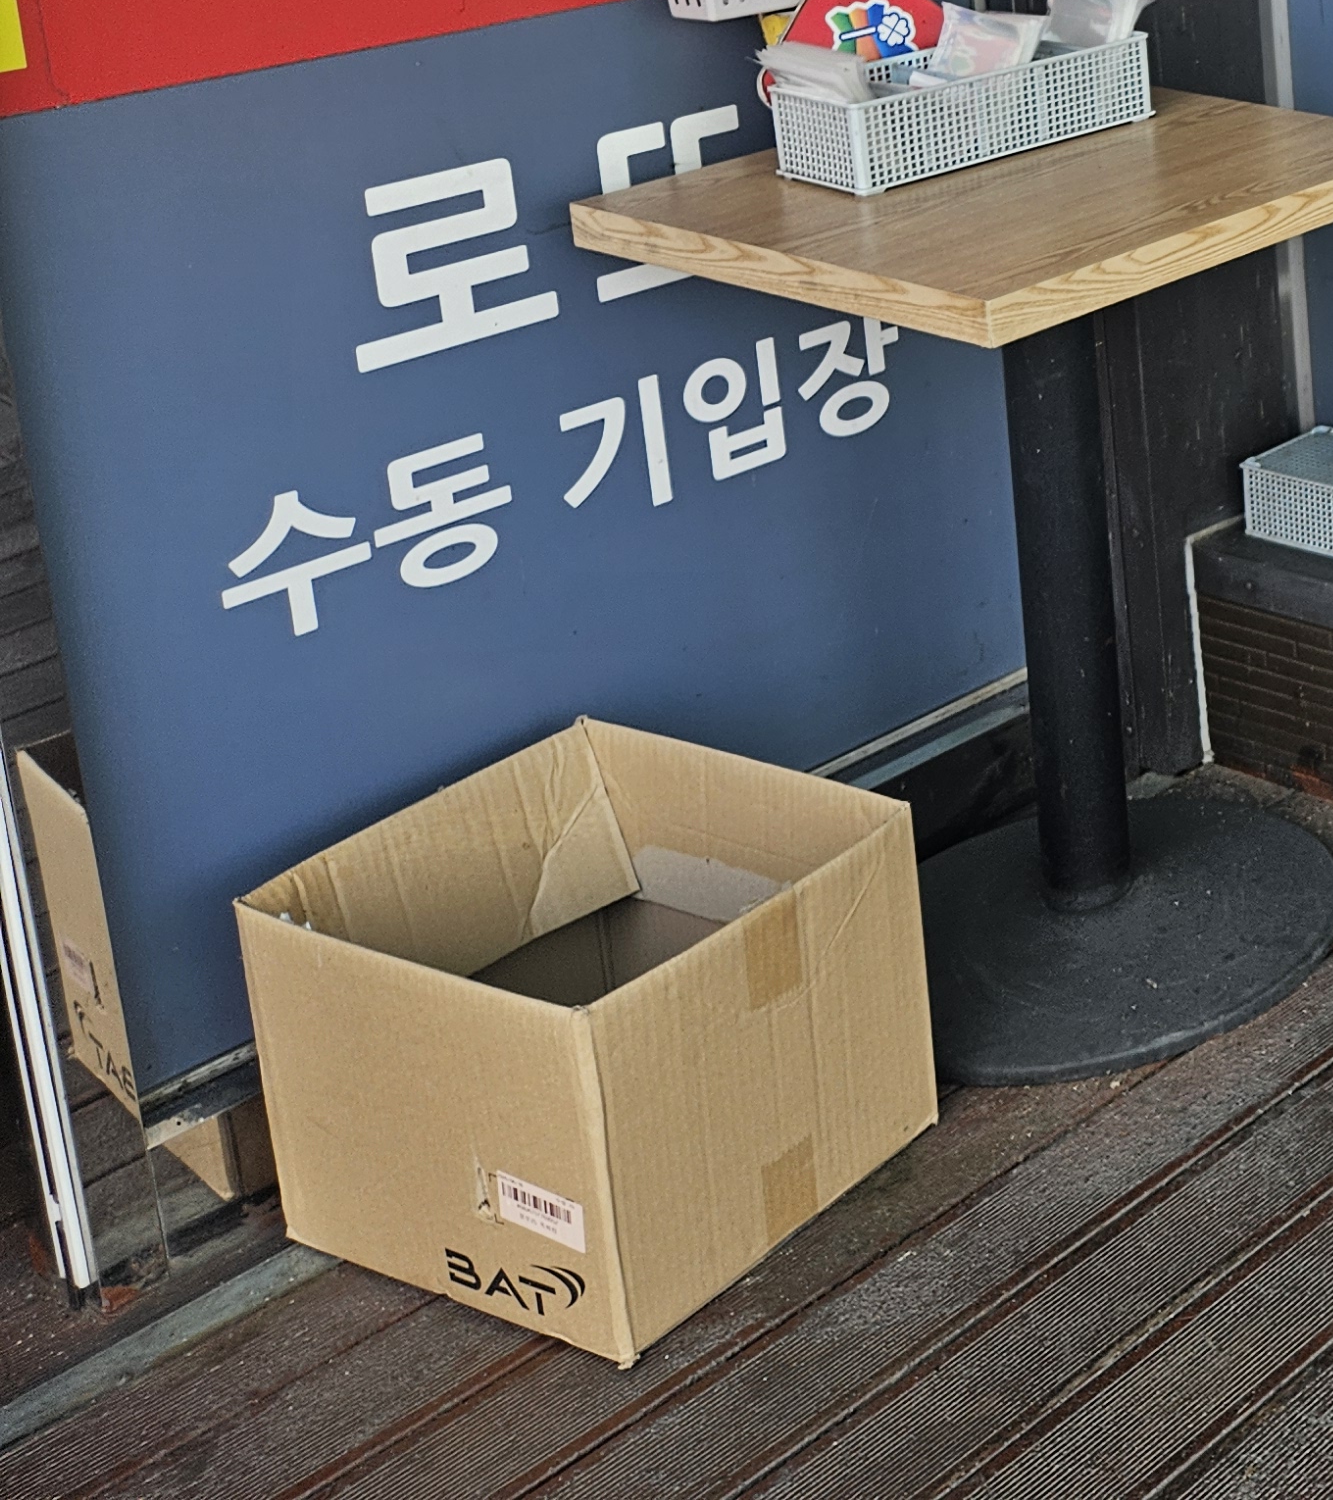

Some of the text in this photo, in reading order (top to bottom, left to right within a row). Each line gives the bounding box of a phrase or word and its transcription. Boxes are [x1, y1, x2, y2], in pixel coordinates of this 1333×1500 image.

[220, 316, 900, 637] 수동 기입장
[444, 1248, 557, 1316] BAT
